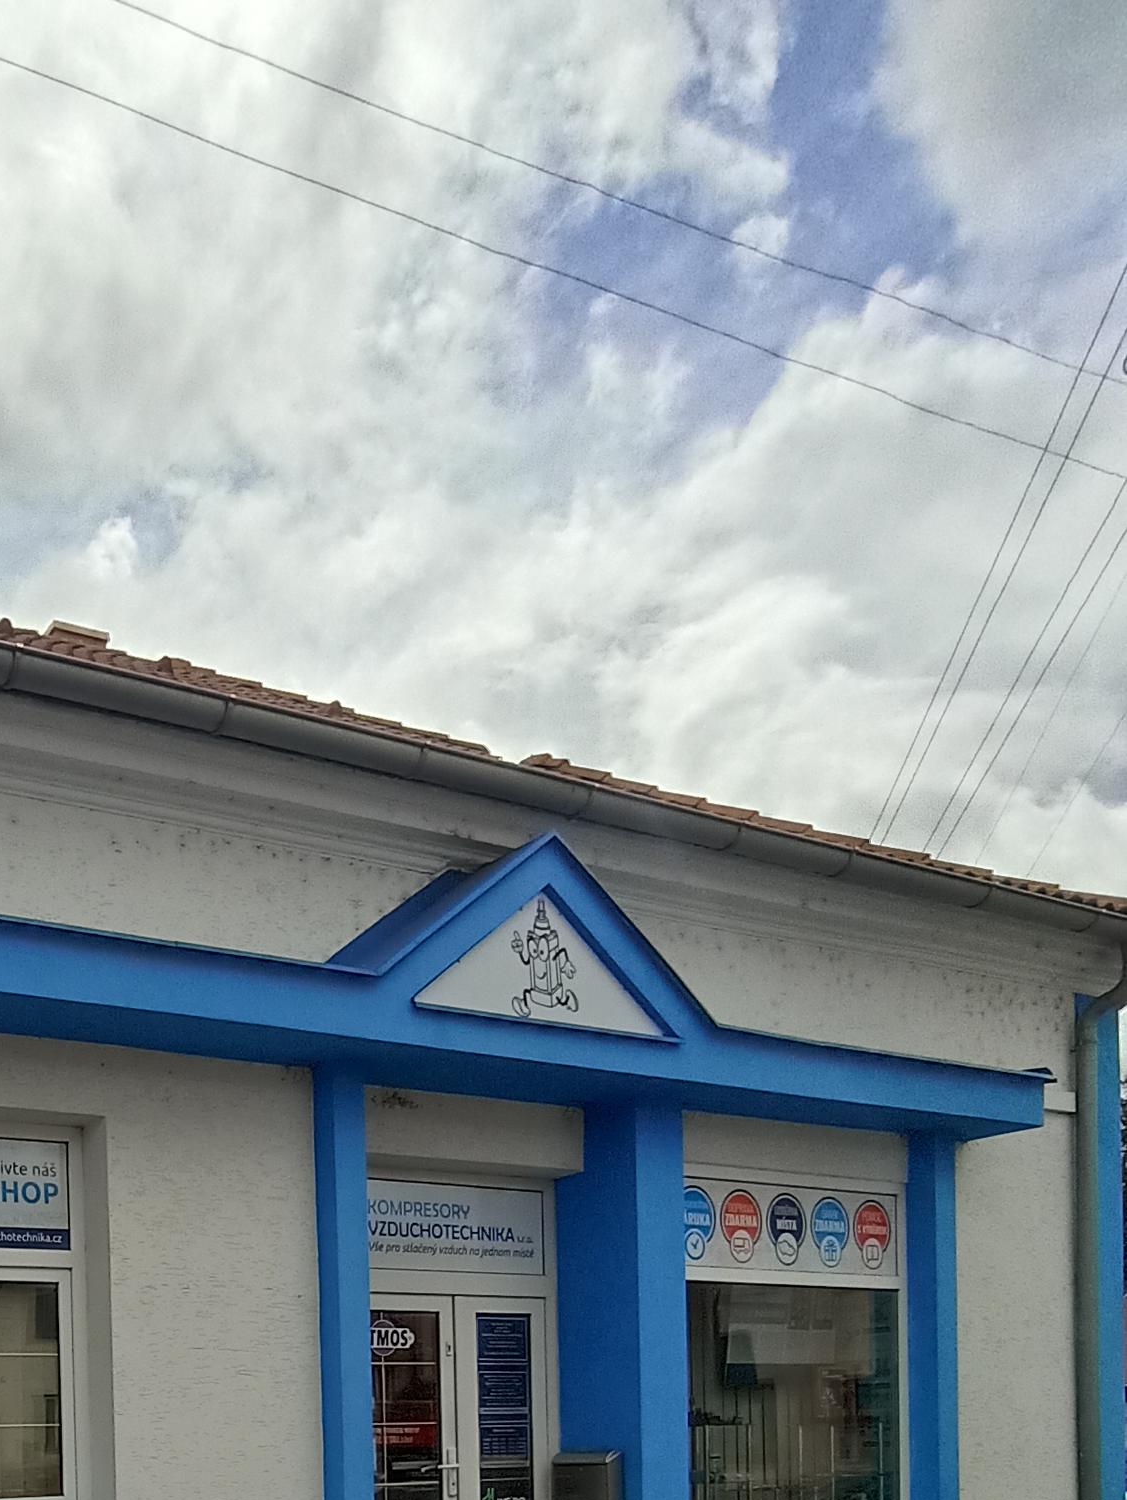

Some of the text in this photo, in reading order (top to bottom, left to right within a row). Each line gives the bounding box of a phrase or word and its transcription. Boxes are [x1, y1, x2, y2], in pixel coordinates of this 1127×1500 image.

[32, 1162, 58, 1178] náš
[368, 1199, 470, 1220] KOMPRESORY
[368, 1220, 515, 1243] VZDUCHOTECHNIKA
[385, 1243, 401, 1255] pro
